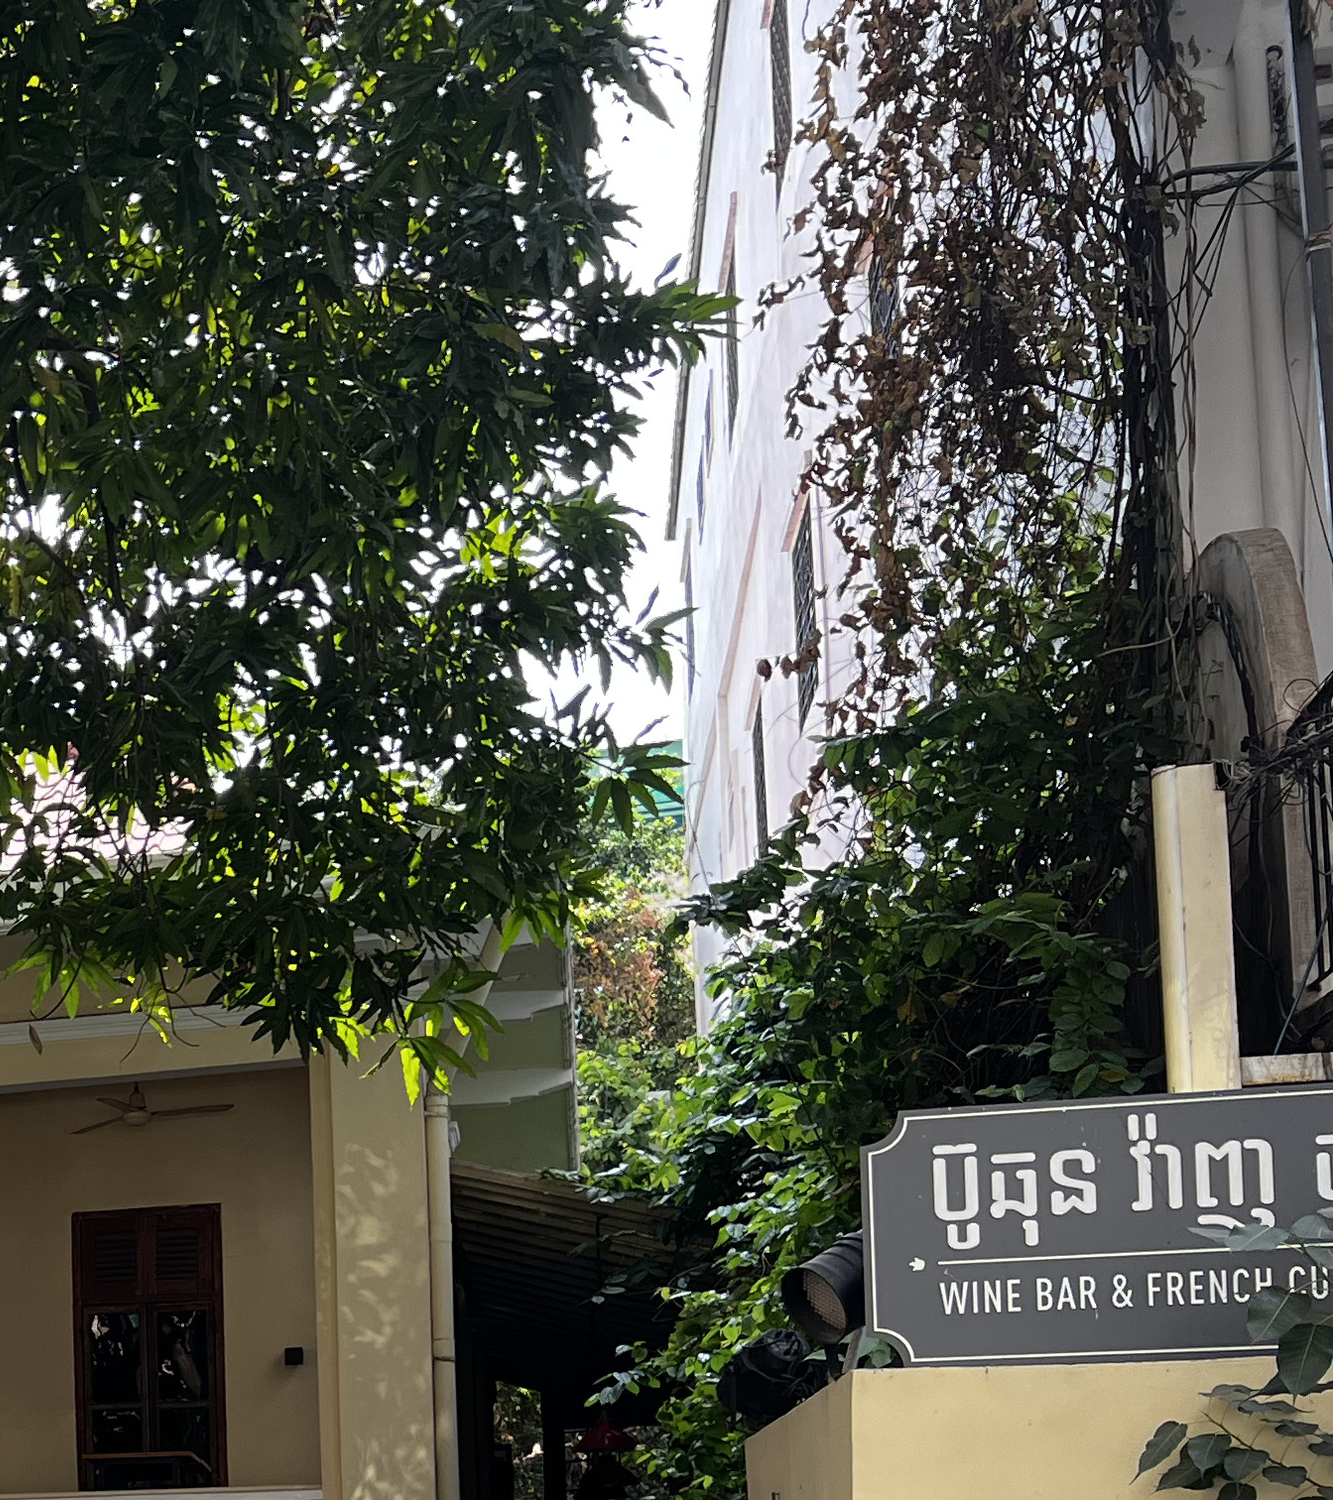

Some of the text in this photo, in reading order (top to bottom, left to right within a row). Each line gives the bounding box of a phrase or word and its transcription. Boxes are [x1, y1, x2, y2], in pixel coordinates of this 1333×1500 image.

[939, 1278, 1022, 1315] WINE
[1036, 1275, 1098, 1312] BAR
[1111, 1273, 1135, 1309] &
[1147, 1265, 1274, 1307] FRENCH
